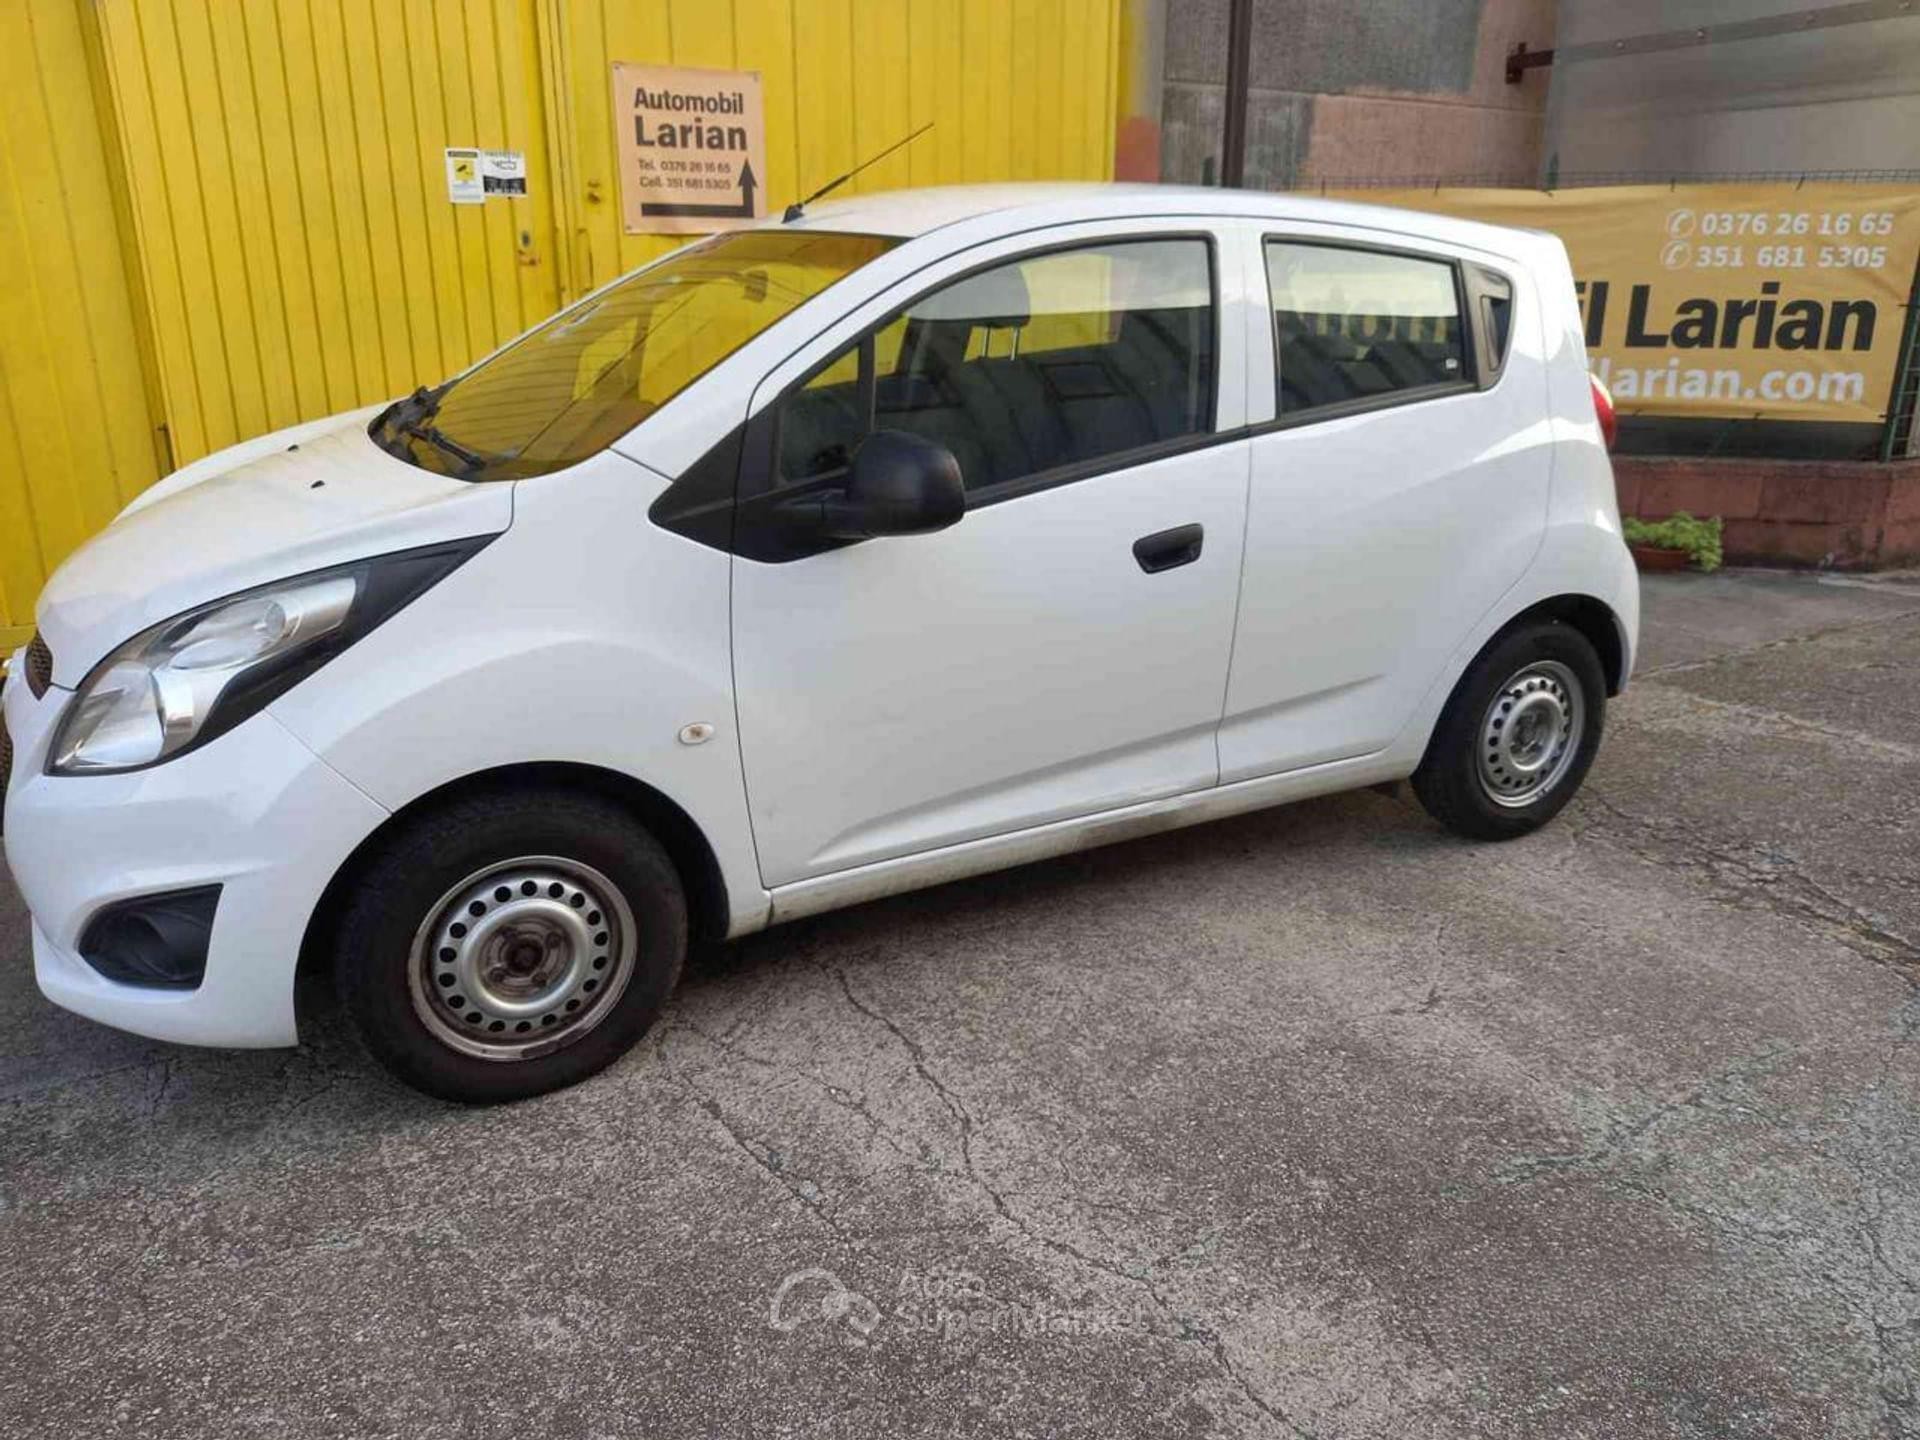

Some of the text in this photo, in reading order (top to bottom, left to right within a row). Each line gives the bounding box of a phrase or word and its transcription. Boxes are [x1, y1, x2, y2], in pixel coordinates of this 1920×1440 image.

[634, 87, 744, 114] Automobil
[635, 116, 747, 150] Larian
[638, 159, 656, 171] Tel.
[660, 160, 687, 171] 0376
[690, 162, 703, 172] 26
[717, 163, 731, 173] 65
[640, 176, 663, 188] Cell.
[667, 177, 683, 189] 351
[705, 179, 731, 190] 5305
[1701, 212, 1894, 235] 0376 26 16 65
[1696, 246, 1887, 269] 351 681 5305
[1625, 281, 1877, 351] Larian
